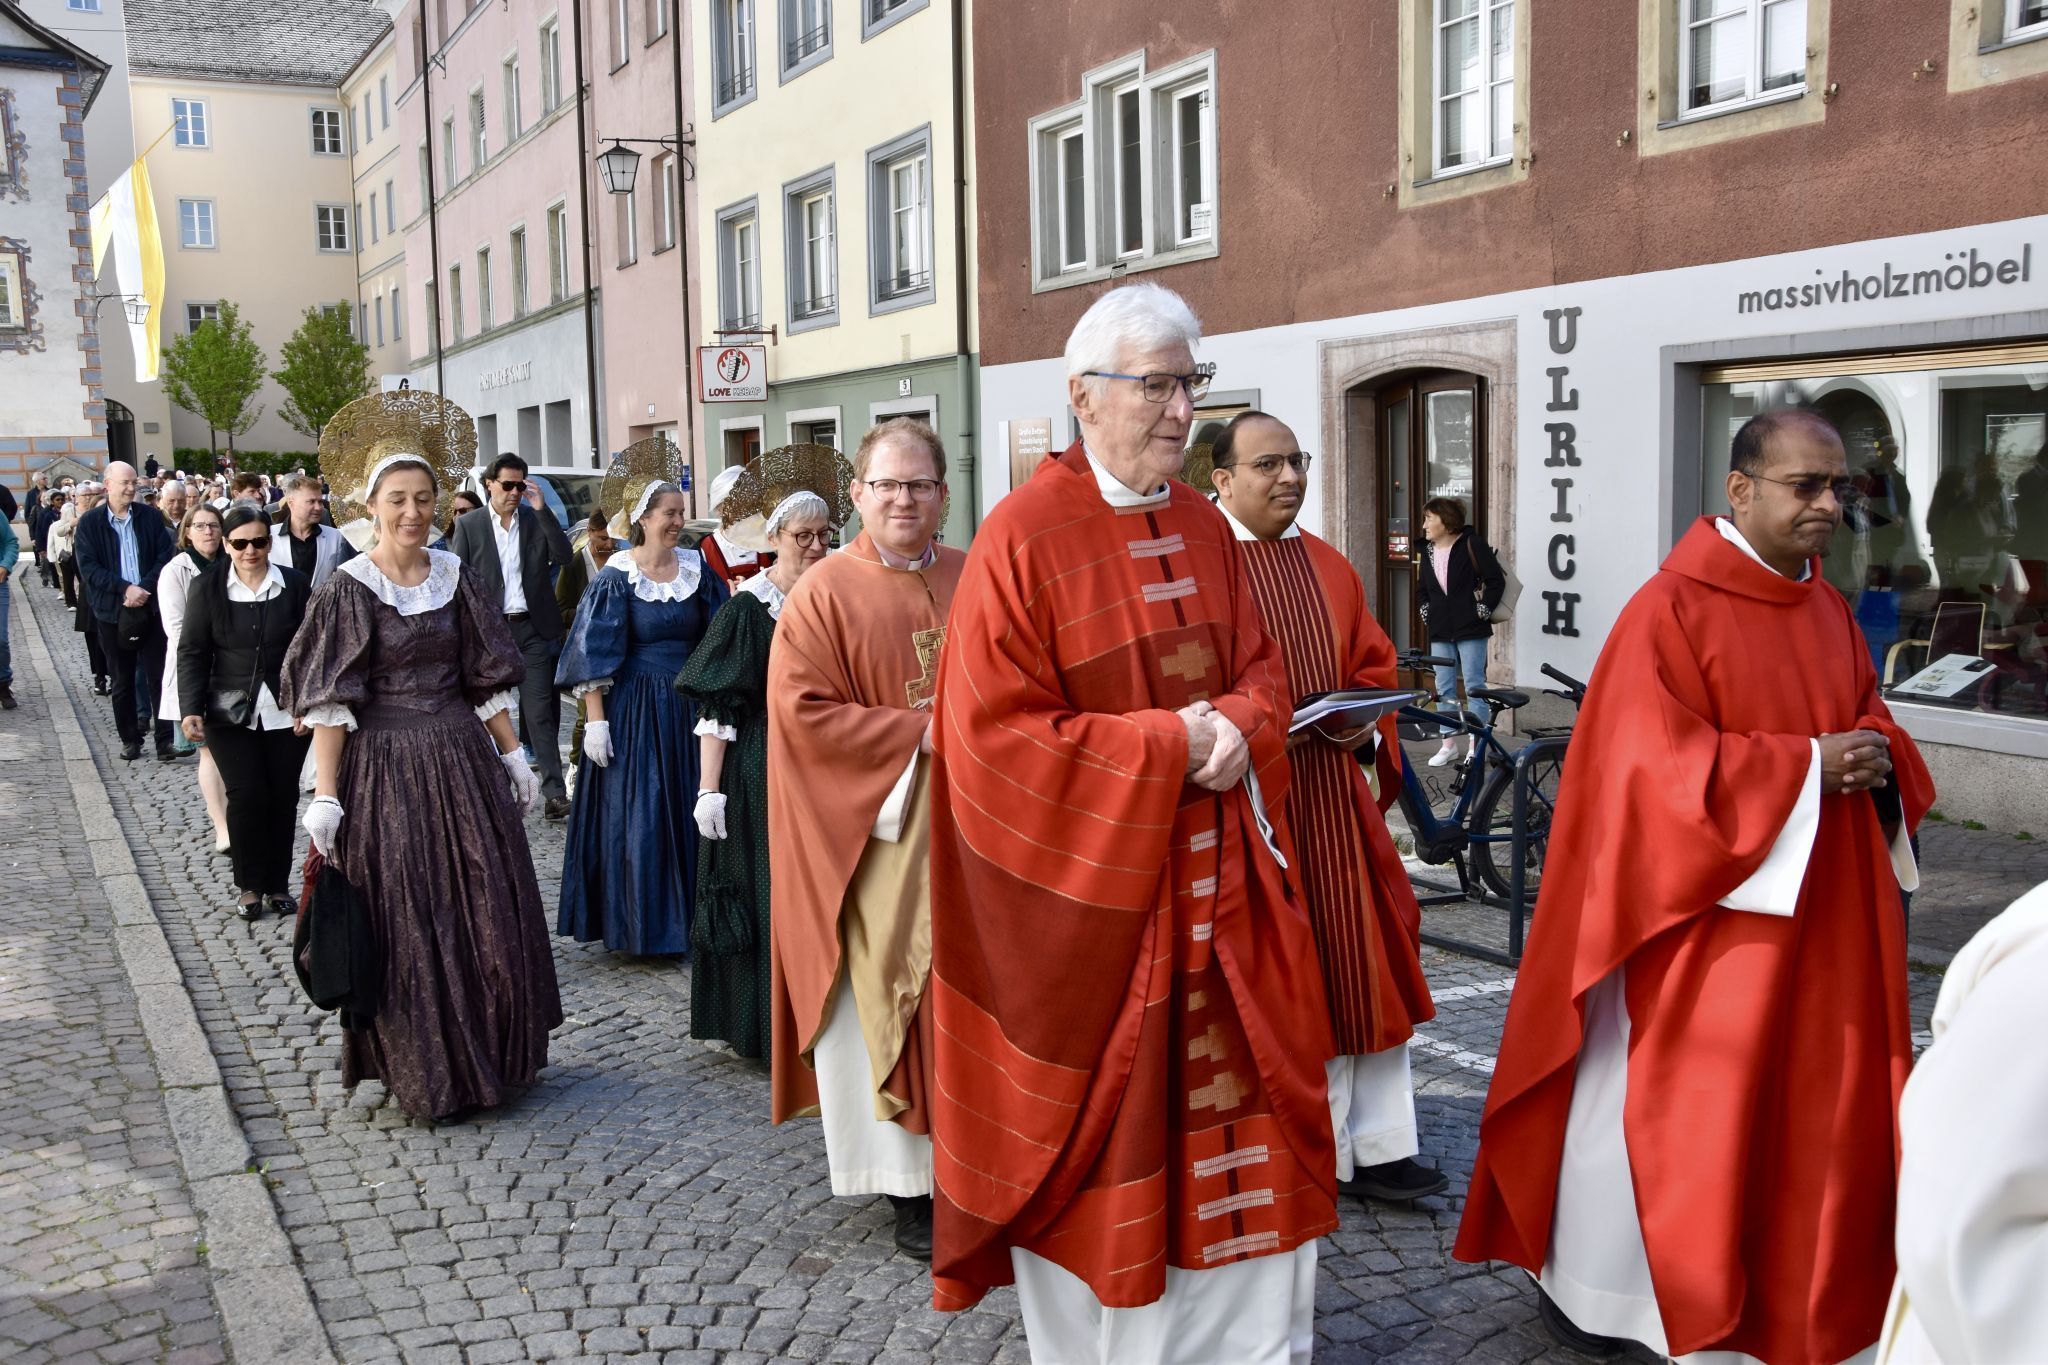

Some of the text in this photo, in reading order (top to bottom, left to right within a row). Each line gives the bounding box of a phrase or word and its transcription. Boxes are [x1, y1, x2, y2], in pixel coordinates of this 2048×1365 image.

[1738, 242, 2031, 313] massivholzmöbel
[1194, 361, 1217, 376] me
[708, 386, 762, 397] LOVE KEBAP
[1542, 306, 1582, 637] ULRICH
[1436, 482, 1466, 497] ulrich
